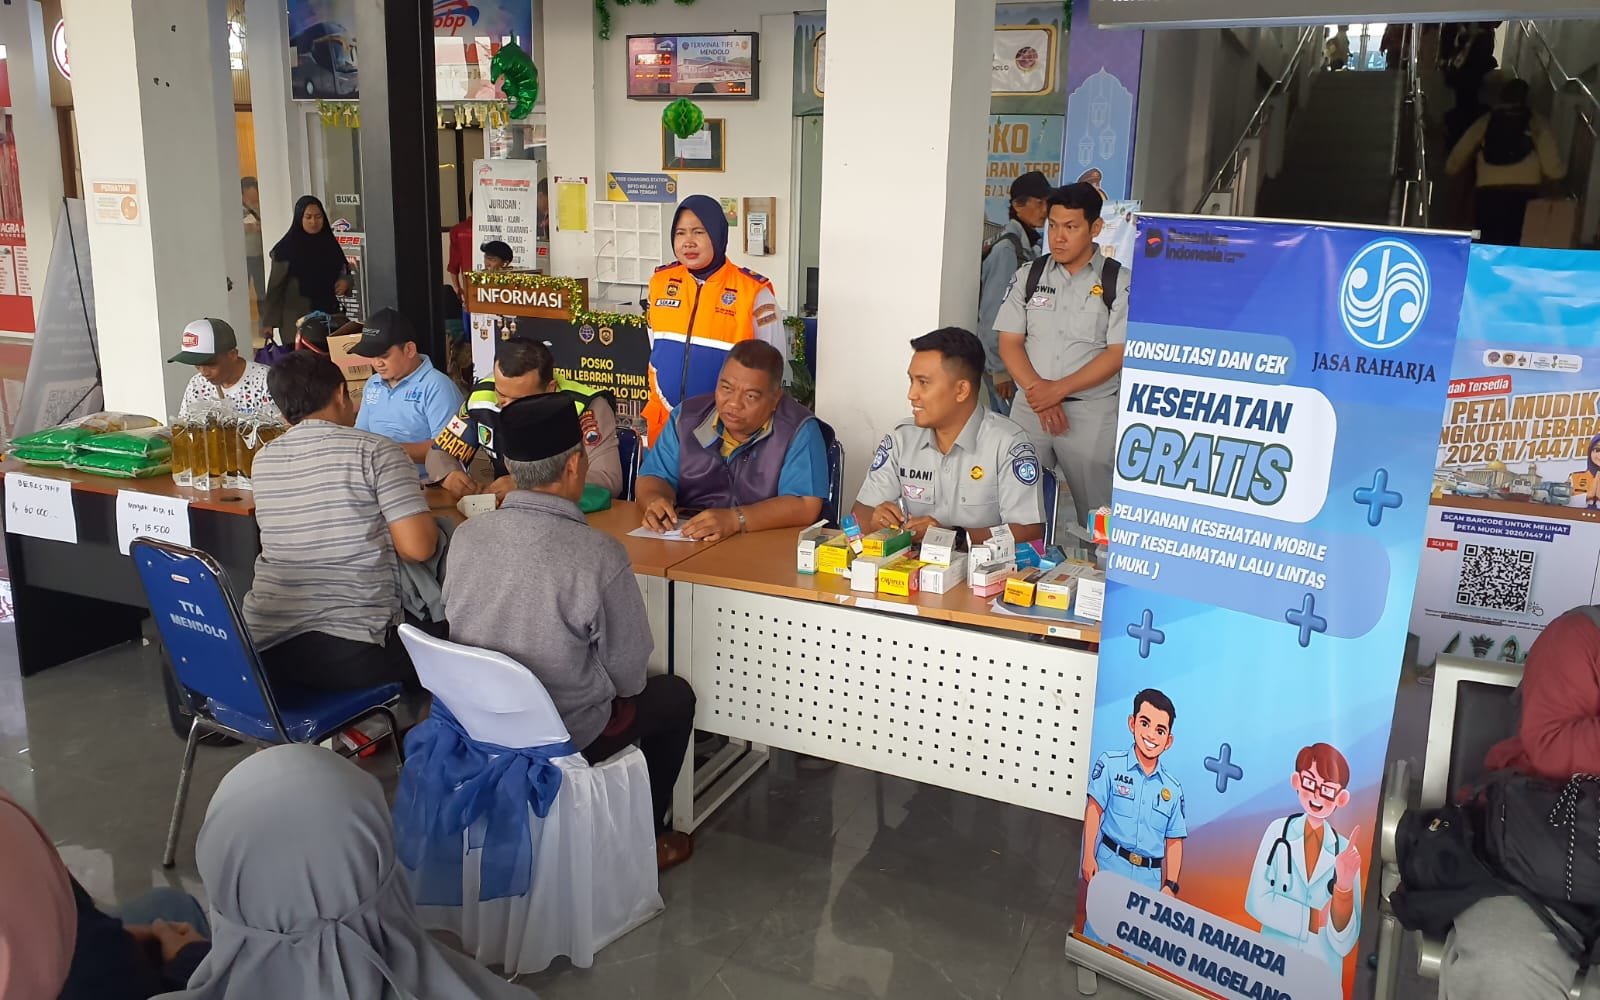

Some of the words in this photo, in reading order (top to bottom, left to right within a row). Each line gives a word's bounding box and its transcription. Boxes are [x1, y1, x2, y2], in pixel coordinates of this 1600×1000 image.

[988, 123, 1029, 154] KO
[986, 162, 1020, 178] RAN
[336, 195, 358, 203] BUKA
[488, 199, 517, 210] JURUSAN
[476, 287, 563, 309] INFORMASI
[580, 356, 614, 371] POSKO
[1124, 339, 1216, 367] KONSULTASI
[1217, 349, 1254, 371] DAN
[1255, 353, 1289, 375] CEK
[1312, 351, 1351, 373] JASA
[1355, 356, 1436, 384] RAHARJA
[574, 370, 613, 384] LEBARAN
[616, 373, 645, 386] TAHUN
[1468, 378, 1509, 393] Tersedia
[1126, 382, 1293, 434] KESEHATAN
[1450, 397, 1507, 425] PETA
[1511, 391, 1600, 420] MUDIK
[1445, 442, 1499, 464] 2026
[1501, 437, 1575, 461] H/1447
[909, 468, 933, 481] DANI
[1116, 422, 1293, 505] GRATIS
[1113, 502, 1189, 532] PELAYANAN
[1191, 518, 1272, 549] KESEHATAN
[1273, 534, 1327, 562] MOBILE
[1443, 513, 1465, 521] SCAN
[1466, 516, 1503, 526] BARCODE
[1504, 520, 1532, 529] UNTUK
[1533, 523, 1569, 533] MELIHAT
[1456, 523, 1476, 531] PETA
[1477, 526, 1503, 535] MUDIK
[1504, 529, 1543, 539] 2026/1447
[1111, 527, 1140, 545] UNIT
[1140, 534, 1238, 569] KESELAMATAN
[1239, 555, 1275, 578] LALU
[1276, 564, 1326, 590] LINTAS
[178, 600, 204, 617] TTA
[169, 613, 228, 641] MENDOLO
[1114, 773, 1134, 785] JASA
[1116, 920, 1187, 967] CABANG
[1126, 891, 1151, 915] PT
[1150, 901, 1195, 938] JASA
[1198, 922, 1287, 976] RAHARJA
